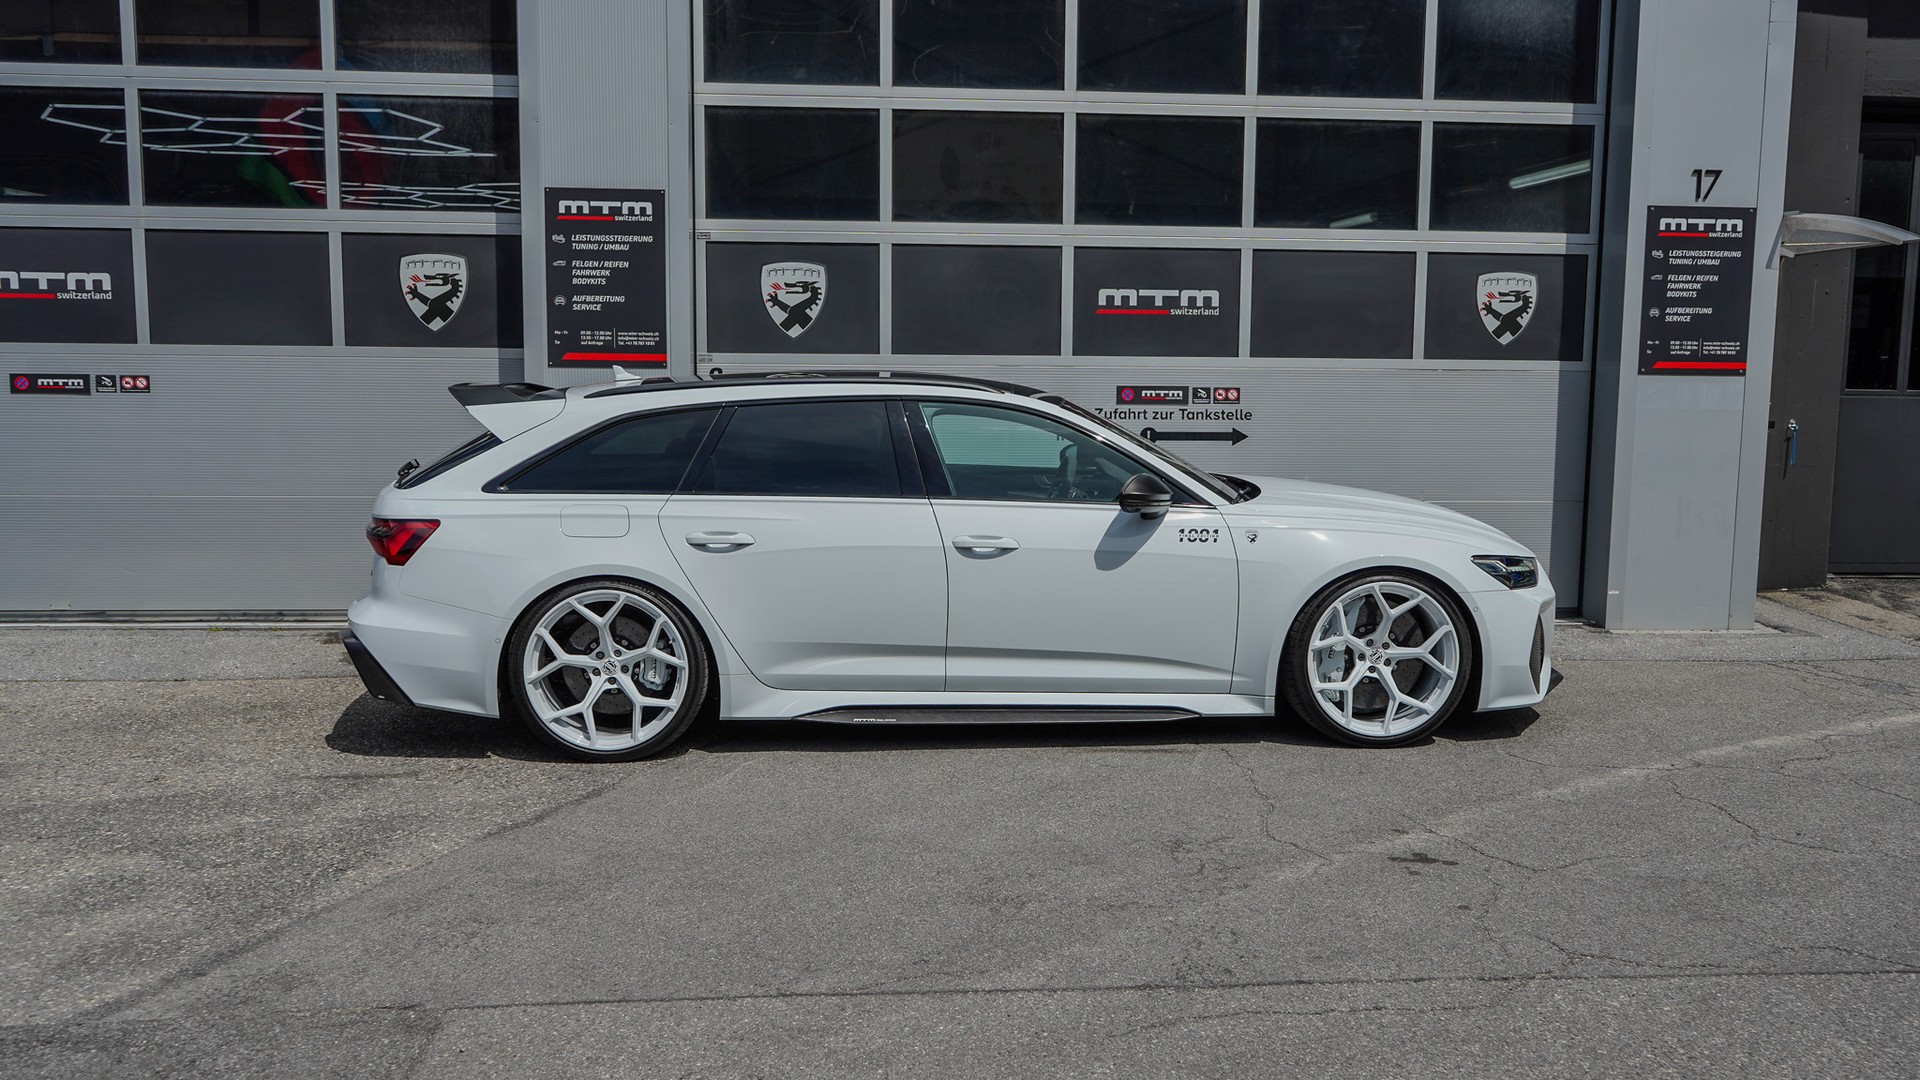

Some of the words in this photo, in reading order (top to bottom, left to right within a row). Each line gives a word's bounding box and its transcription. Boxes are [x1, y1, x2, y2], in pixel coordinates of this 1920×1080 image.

[1690, 169, 1723, 202] 17
[571, 234, 654, 243] LEISTUNGSSTEIGERUNG
[604, 243, 630, 251] UMBAU
[1668, 249, 1742, 258] LEISTUNGSSTEIGERUNG
[571, 260, 599, 268] FELGEN
[603, 260, 630, 268] REIFEN
[1697, 258, 1720, 266] UMBAU
[571, 269, 611, 277] FAHRWERK
[572, 277, 607, 285] BODYKITS
[1696, 274, 1719, 282] REIFEN
[1667, 282, 1702, 290] FAHRWERK
[56, 291, 112, 300] switzerland
[1666, 290, 1697, 298] BODYKITS
[571, 295, 626, 303] AUFBEREITUNG
[572, 303, 602, 311] SERVICE
[1170, 307, 1220, 316] switzerland
[1152, 410, 1175, 420] zur
[1178, 408, 1253, 421] Tankstelle
